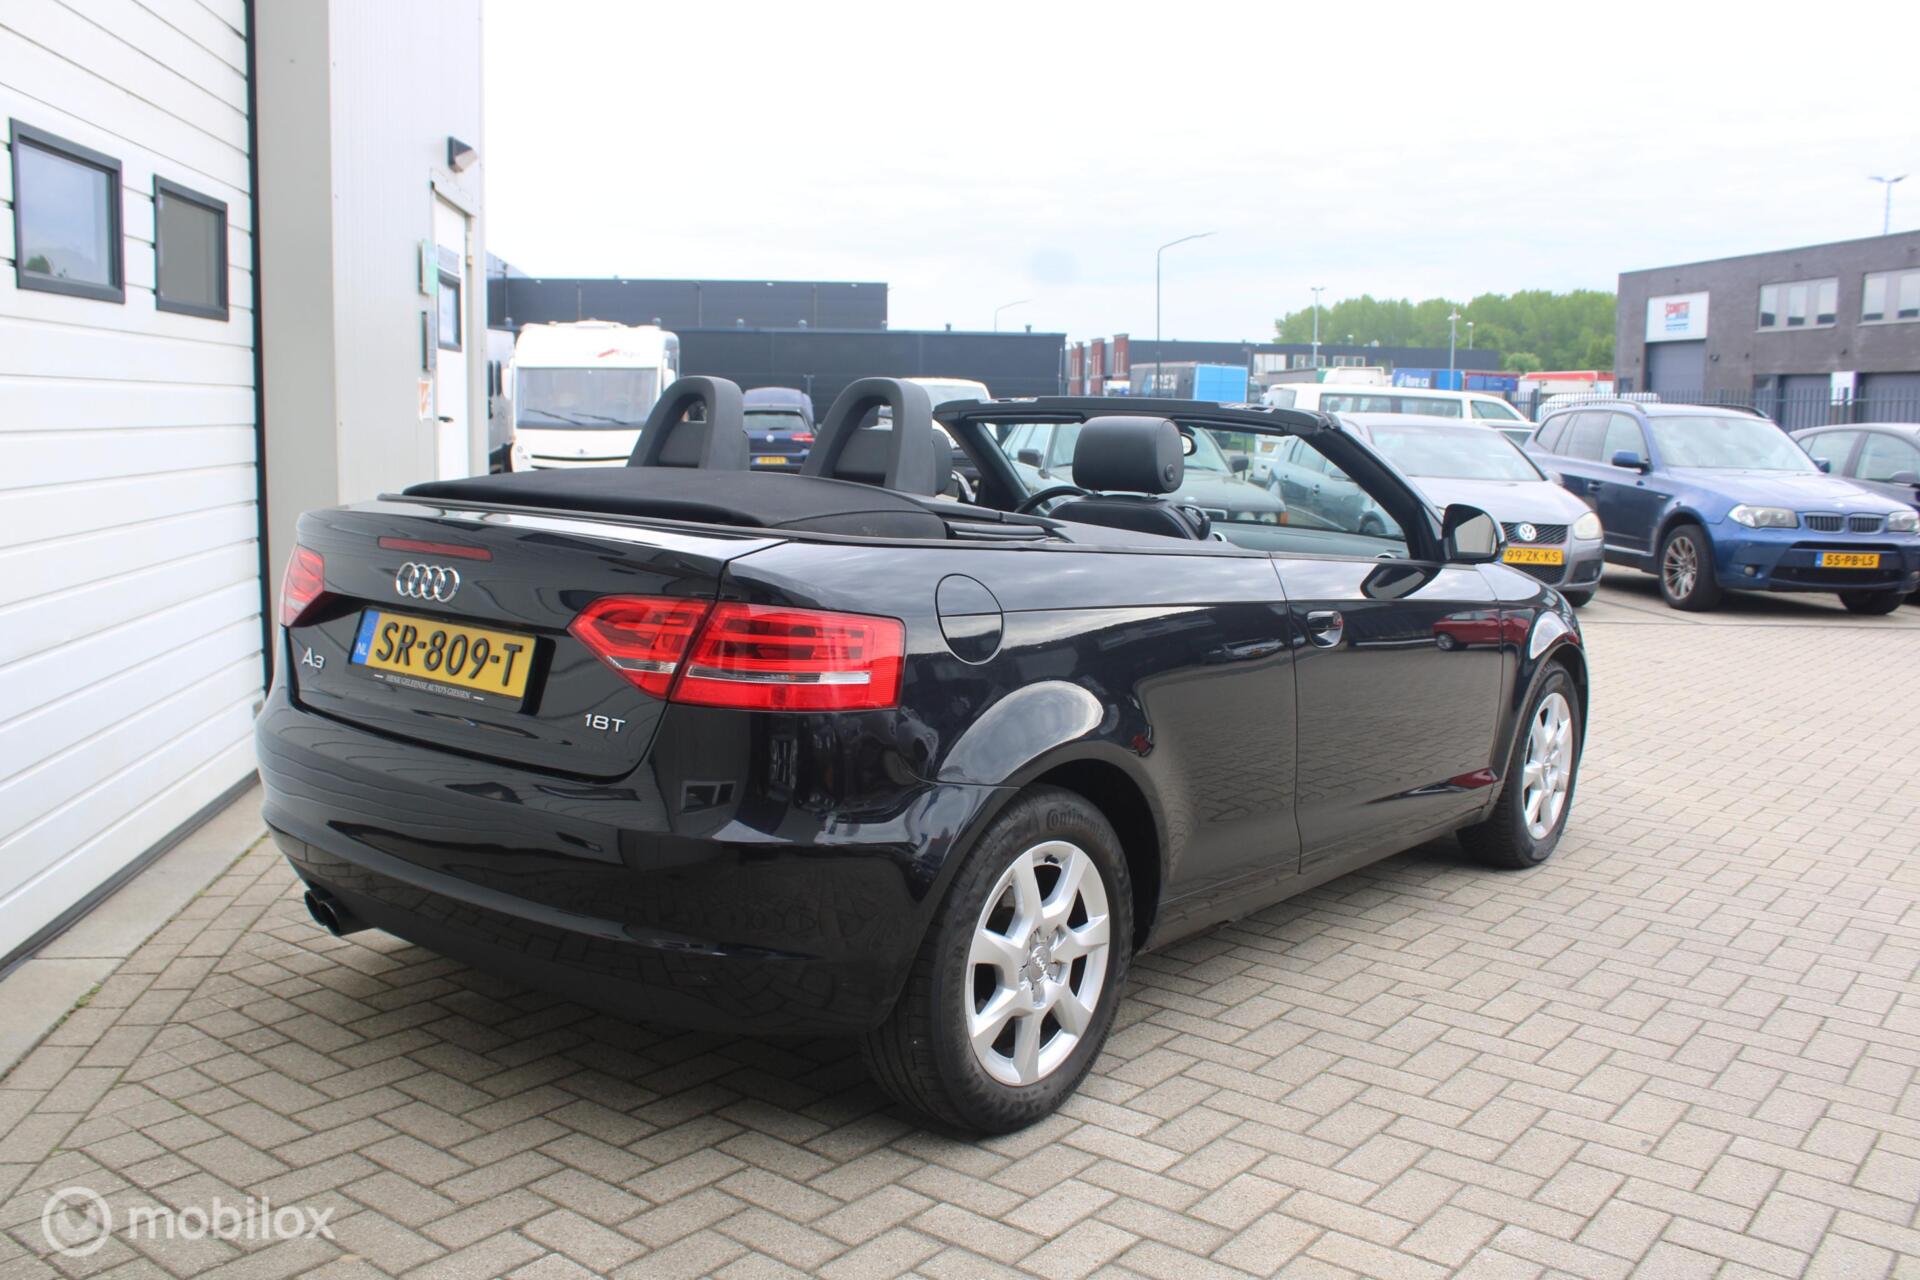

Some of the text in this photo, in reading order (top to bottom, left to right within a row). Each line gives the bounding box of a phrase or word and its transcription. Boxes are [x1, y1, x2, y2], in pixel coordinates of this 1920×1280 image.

[301, 647, 325, 669] A3
[355, 642, 368, 656] NL
[375, 621, 524, 688] SR-809-T
